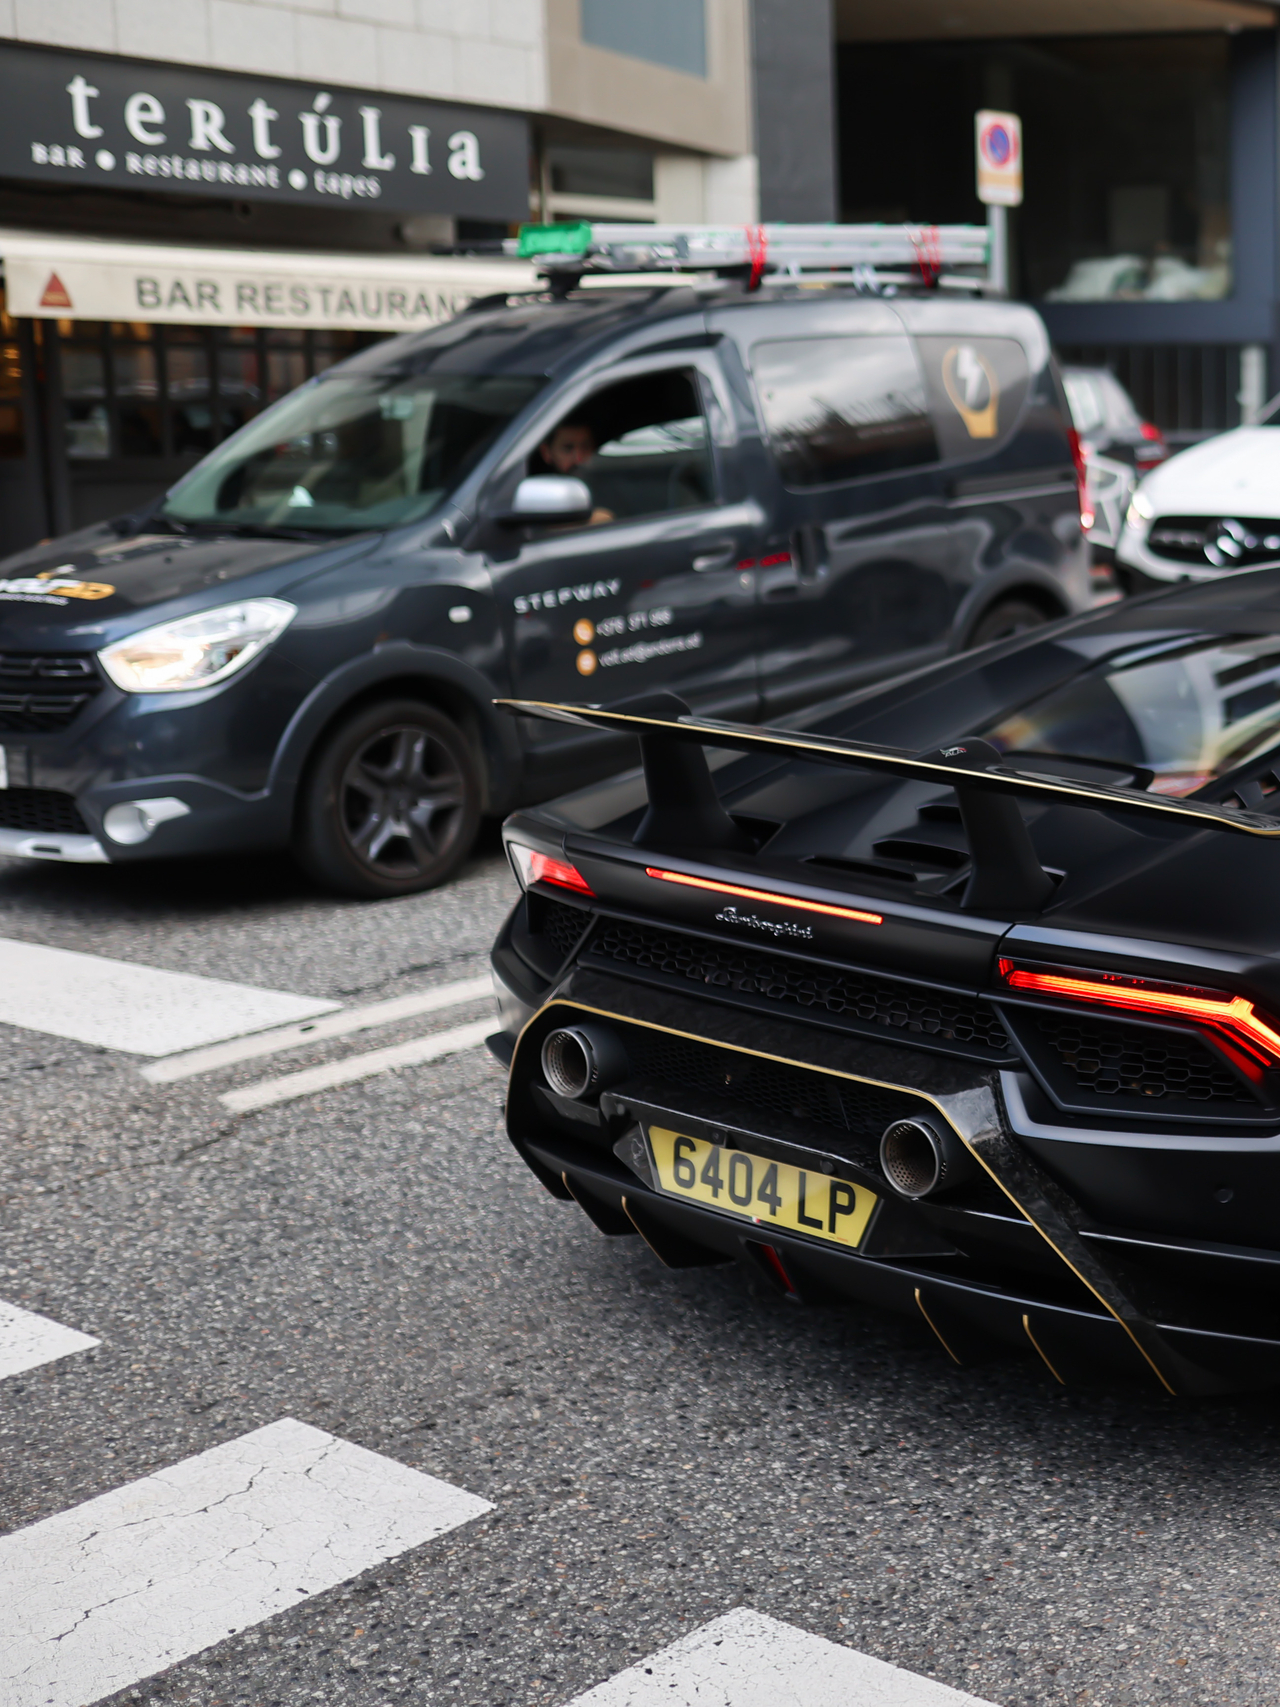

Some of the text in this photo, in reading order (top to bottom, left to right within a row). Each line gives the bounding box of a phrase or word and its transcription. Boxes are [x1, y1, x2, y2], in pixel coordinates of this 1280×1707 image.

[313, 168, 382, 199] tapes
[136, 275, 222, 313] BAR
[514, 577, 622, 614] STEPWAY
[673, 1136, 856, 1234] 6404 LP
